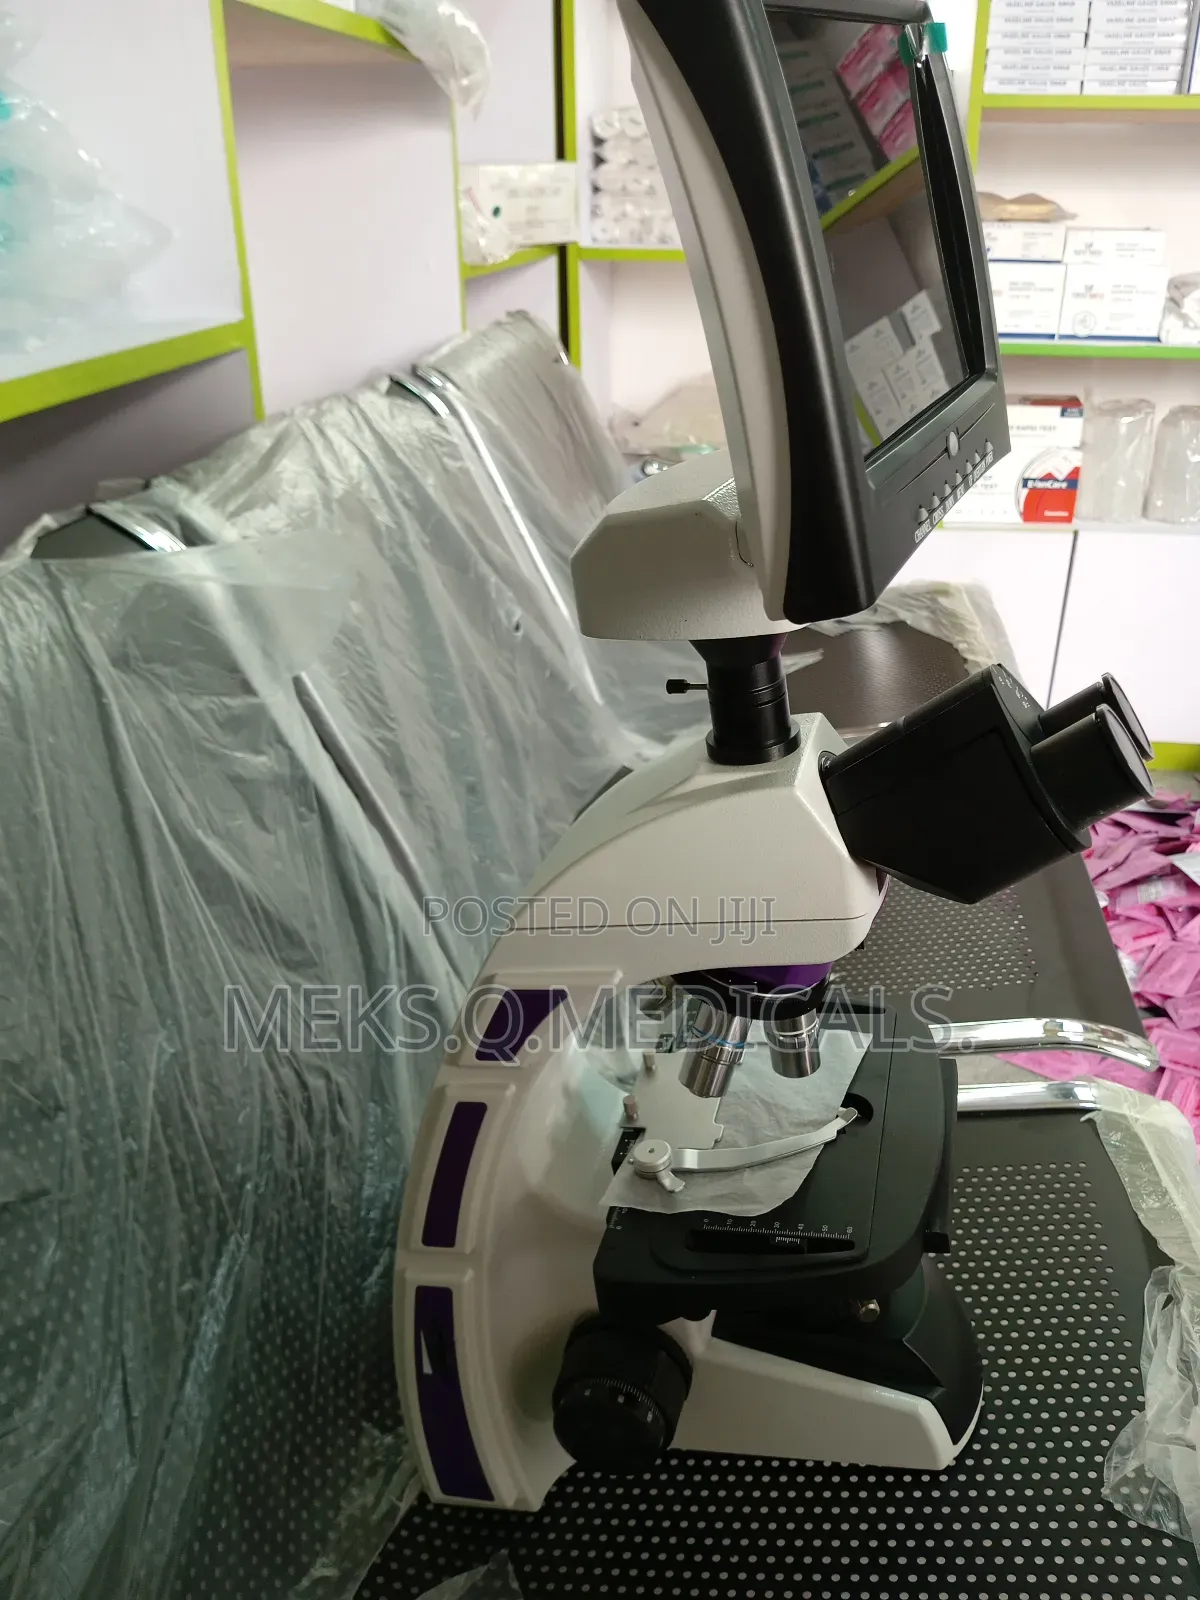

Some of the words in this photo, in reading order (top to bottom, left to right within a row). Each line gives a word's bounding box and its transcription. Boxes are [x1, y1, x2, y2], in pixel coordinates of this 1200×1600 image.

[914, 518, 932, 544] CHANNEL
[773, 1221, 780, 1229] 30
[821, 1224, 828, 1232] 50
[846, 1226, 853, 1234] 60
